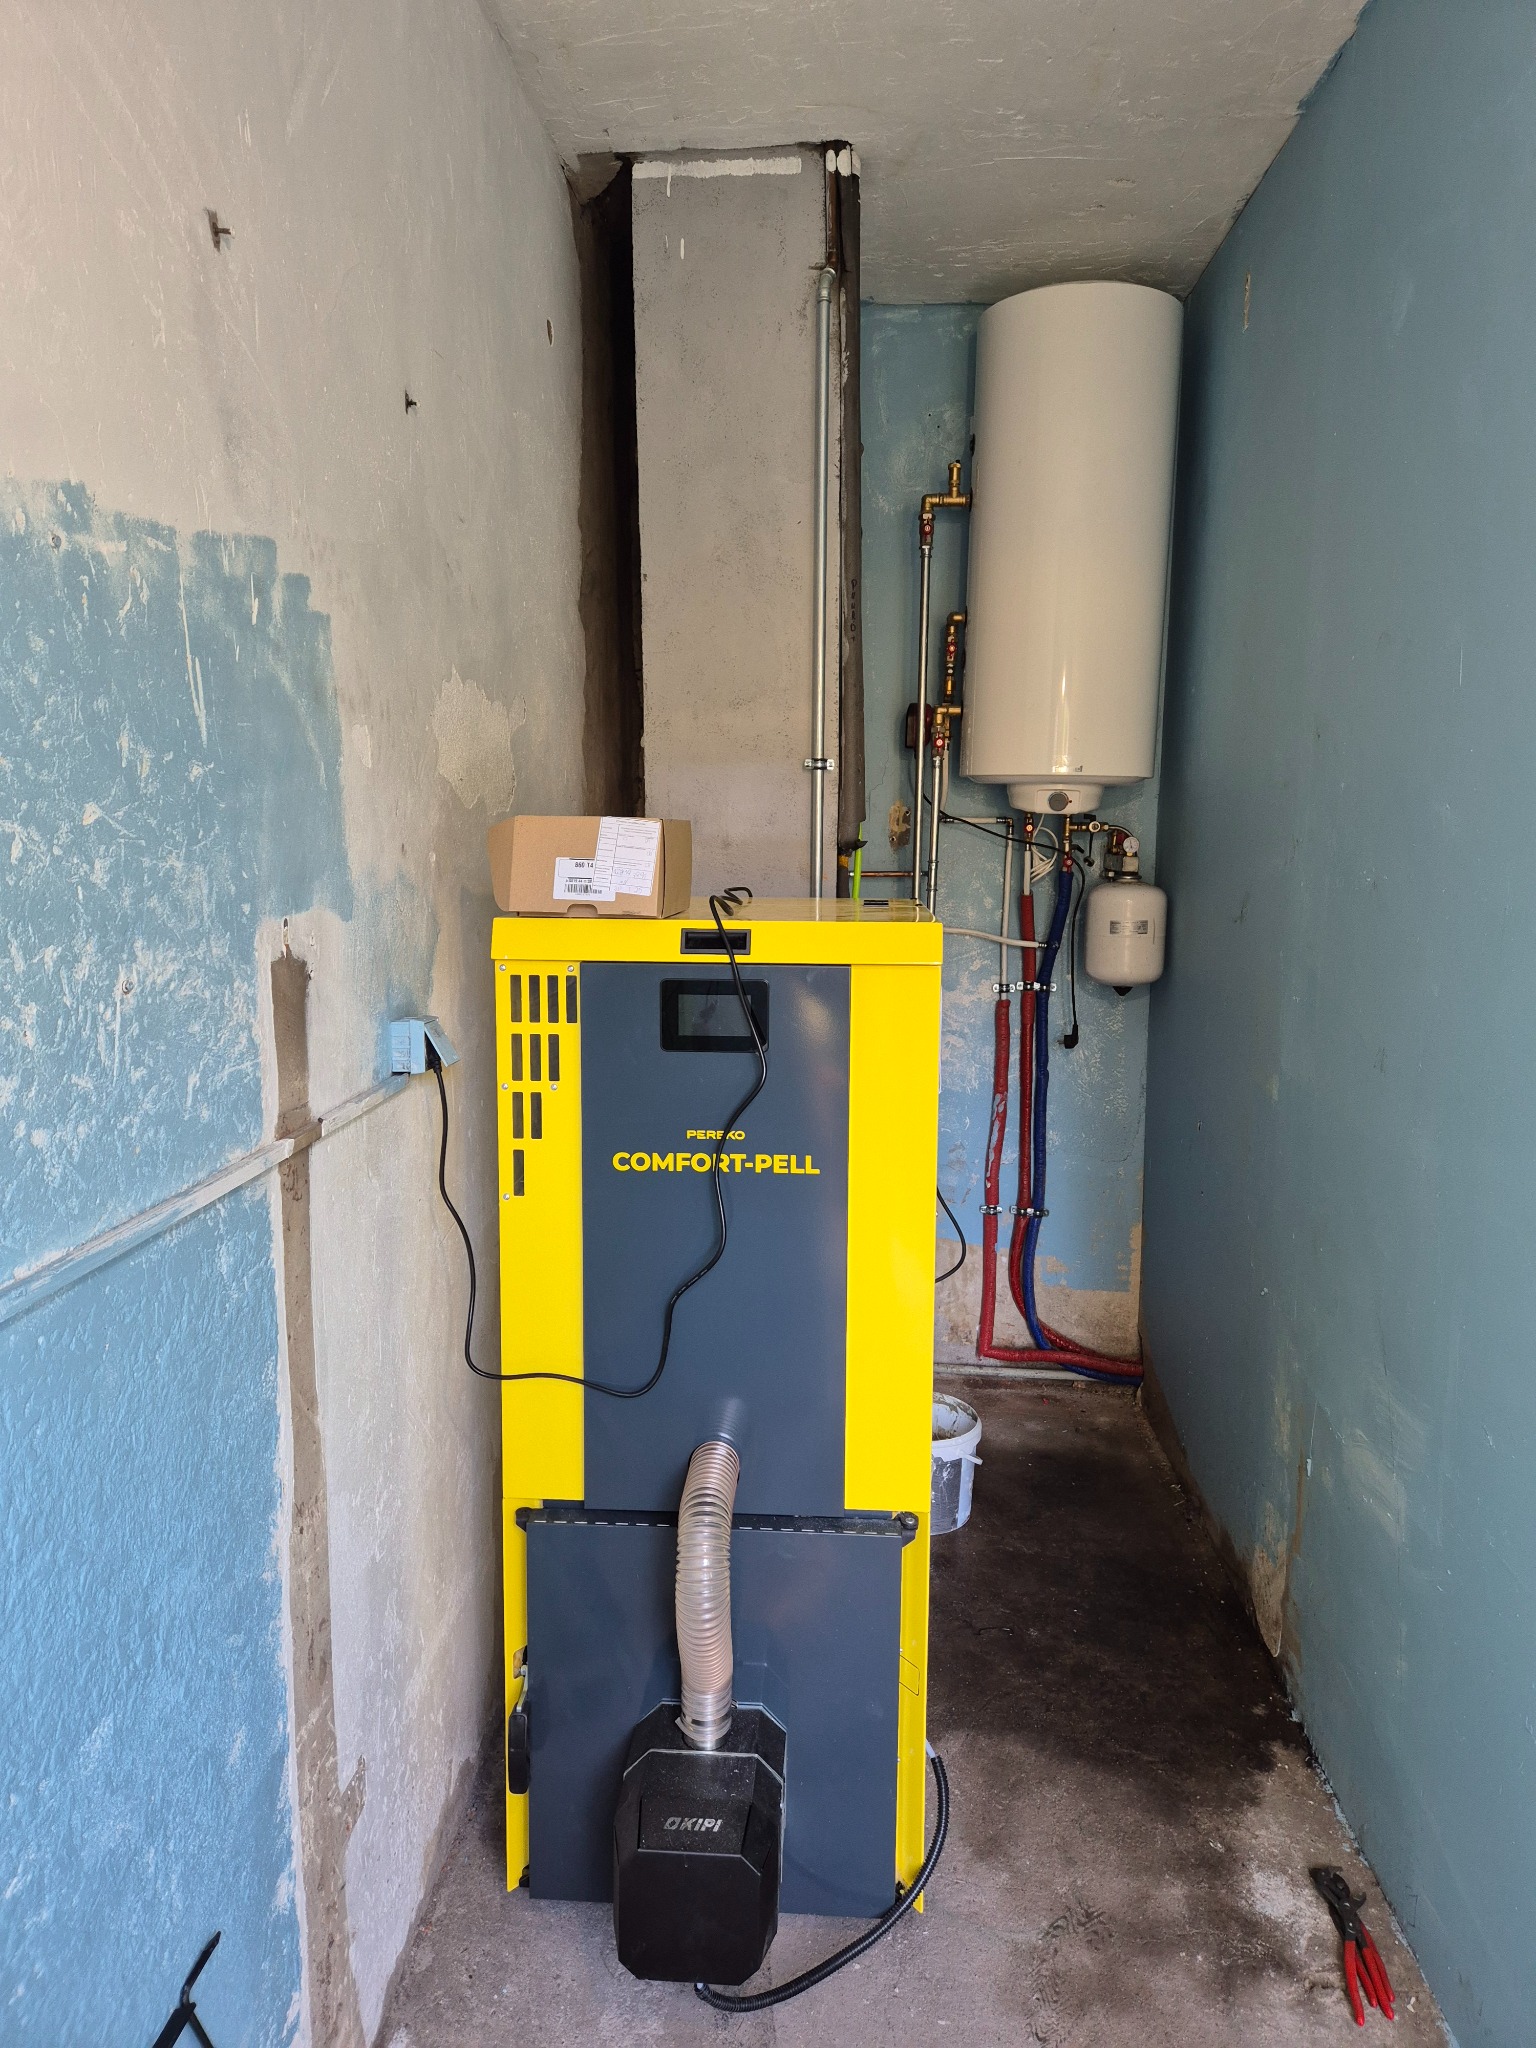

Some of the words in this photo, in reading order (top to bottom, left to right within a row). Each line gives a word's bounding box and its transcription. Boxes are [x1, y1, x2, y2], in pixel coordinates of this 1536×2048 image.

[686, 1129, 746, 1141] PEREKO
[612, 1151, 821, 1175] COMFORT-PELL
[663, 1816, 723, 1833] OKIPI
